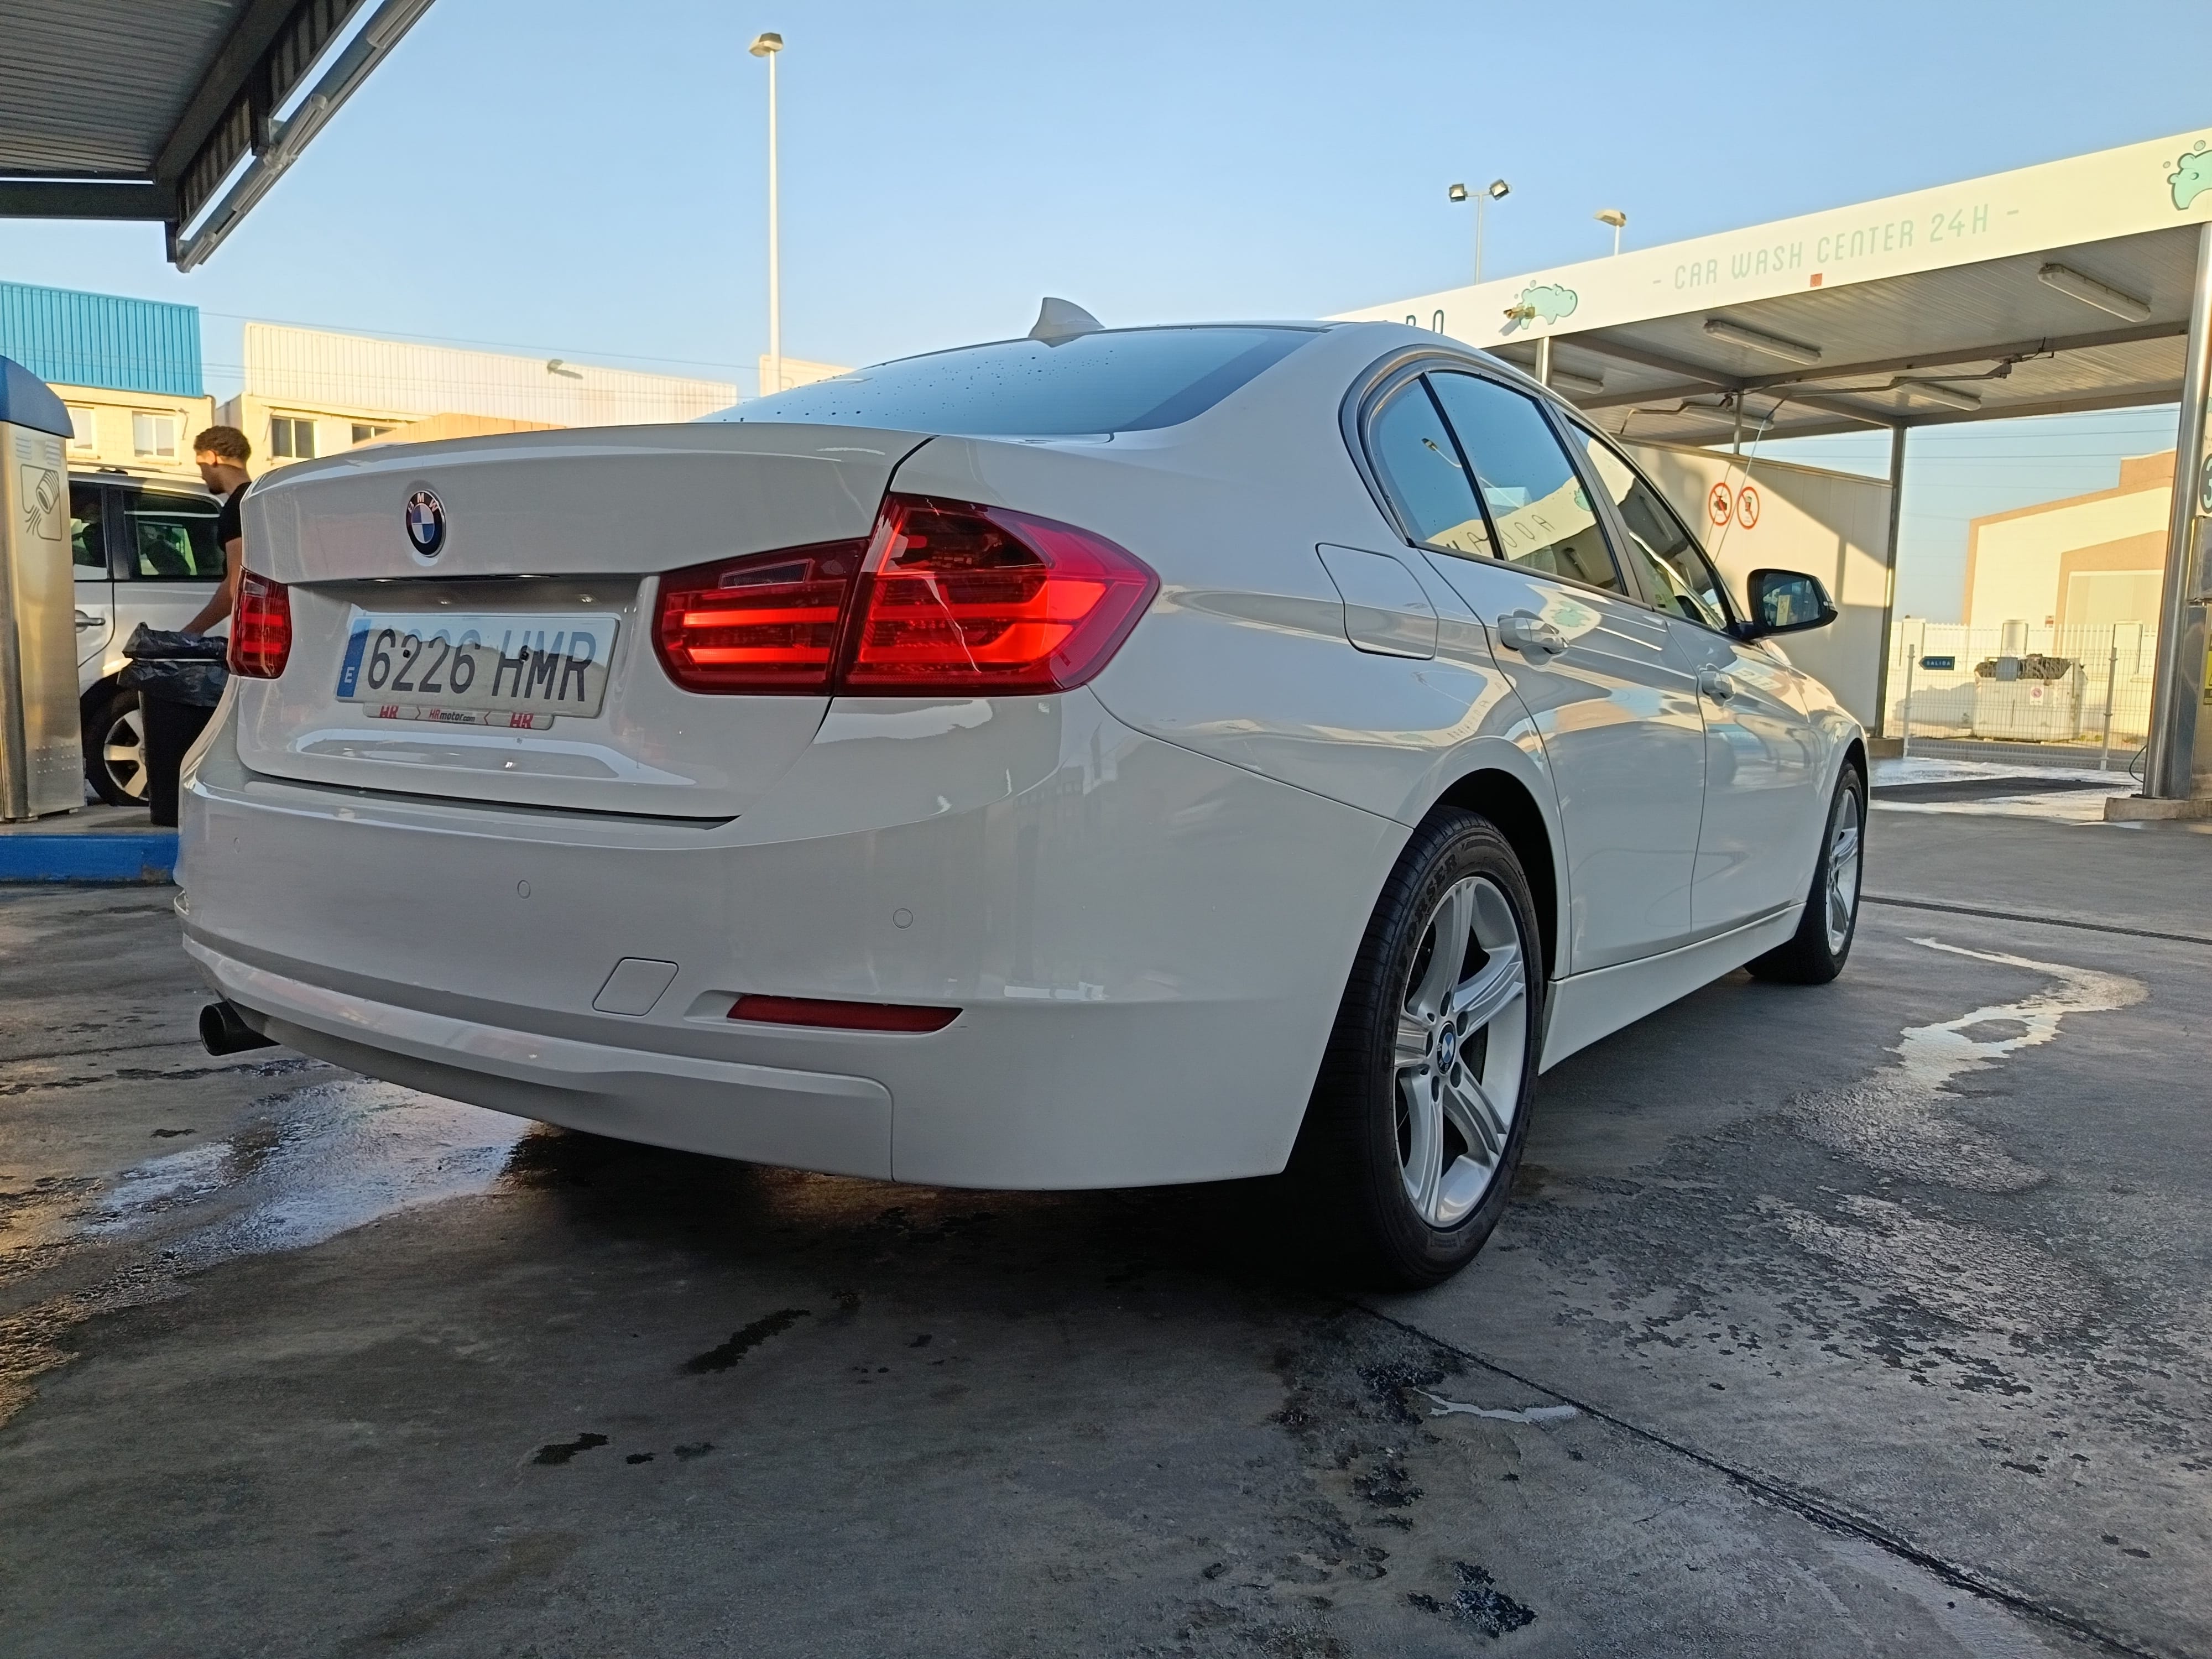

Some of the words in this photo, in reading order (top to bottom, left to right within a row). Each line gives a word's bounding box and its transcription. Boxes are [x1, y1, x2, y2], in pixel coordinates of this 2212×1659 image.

[1674, 259, 1718, 289] CAR
[1731, 242, 1802, 279] WASH
[1817, 220, 1914, 263] CENTER
[1929, 204, 1989, 242] 24H
[368, 628, 482, 694] 6226
[491, 630, 597, 702] HMR
[343, 666, 356, 684] E
[379, 705, 399, 719] HR
[509, 712, 534, 729] HR
